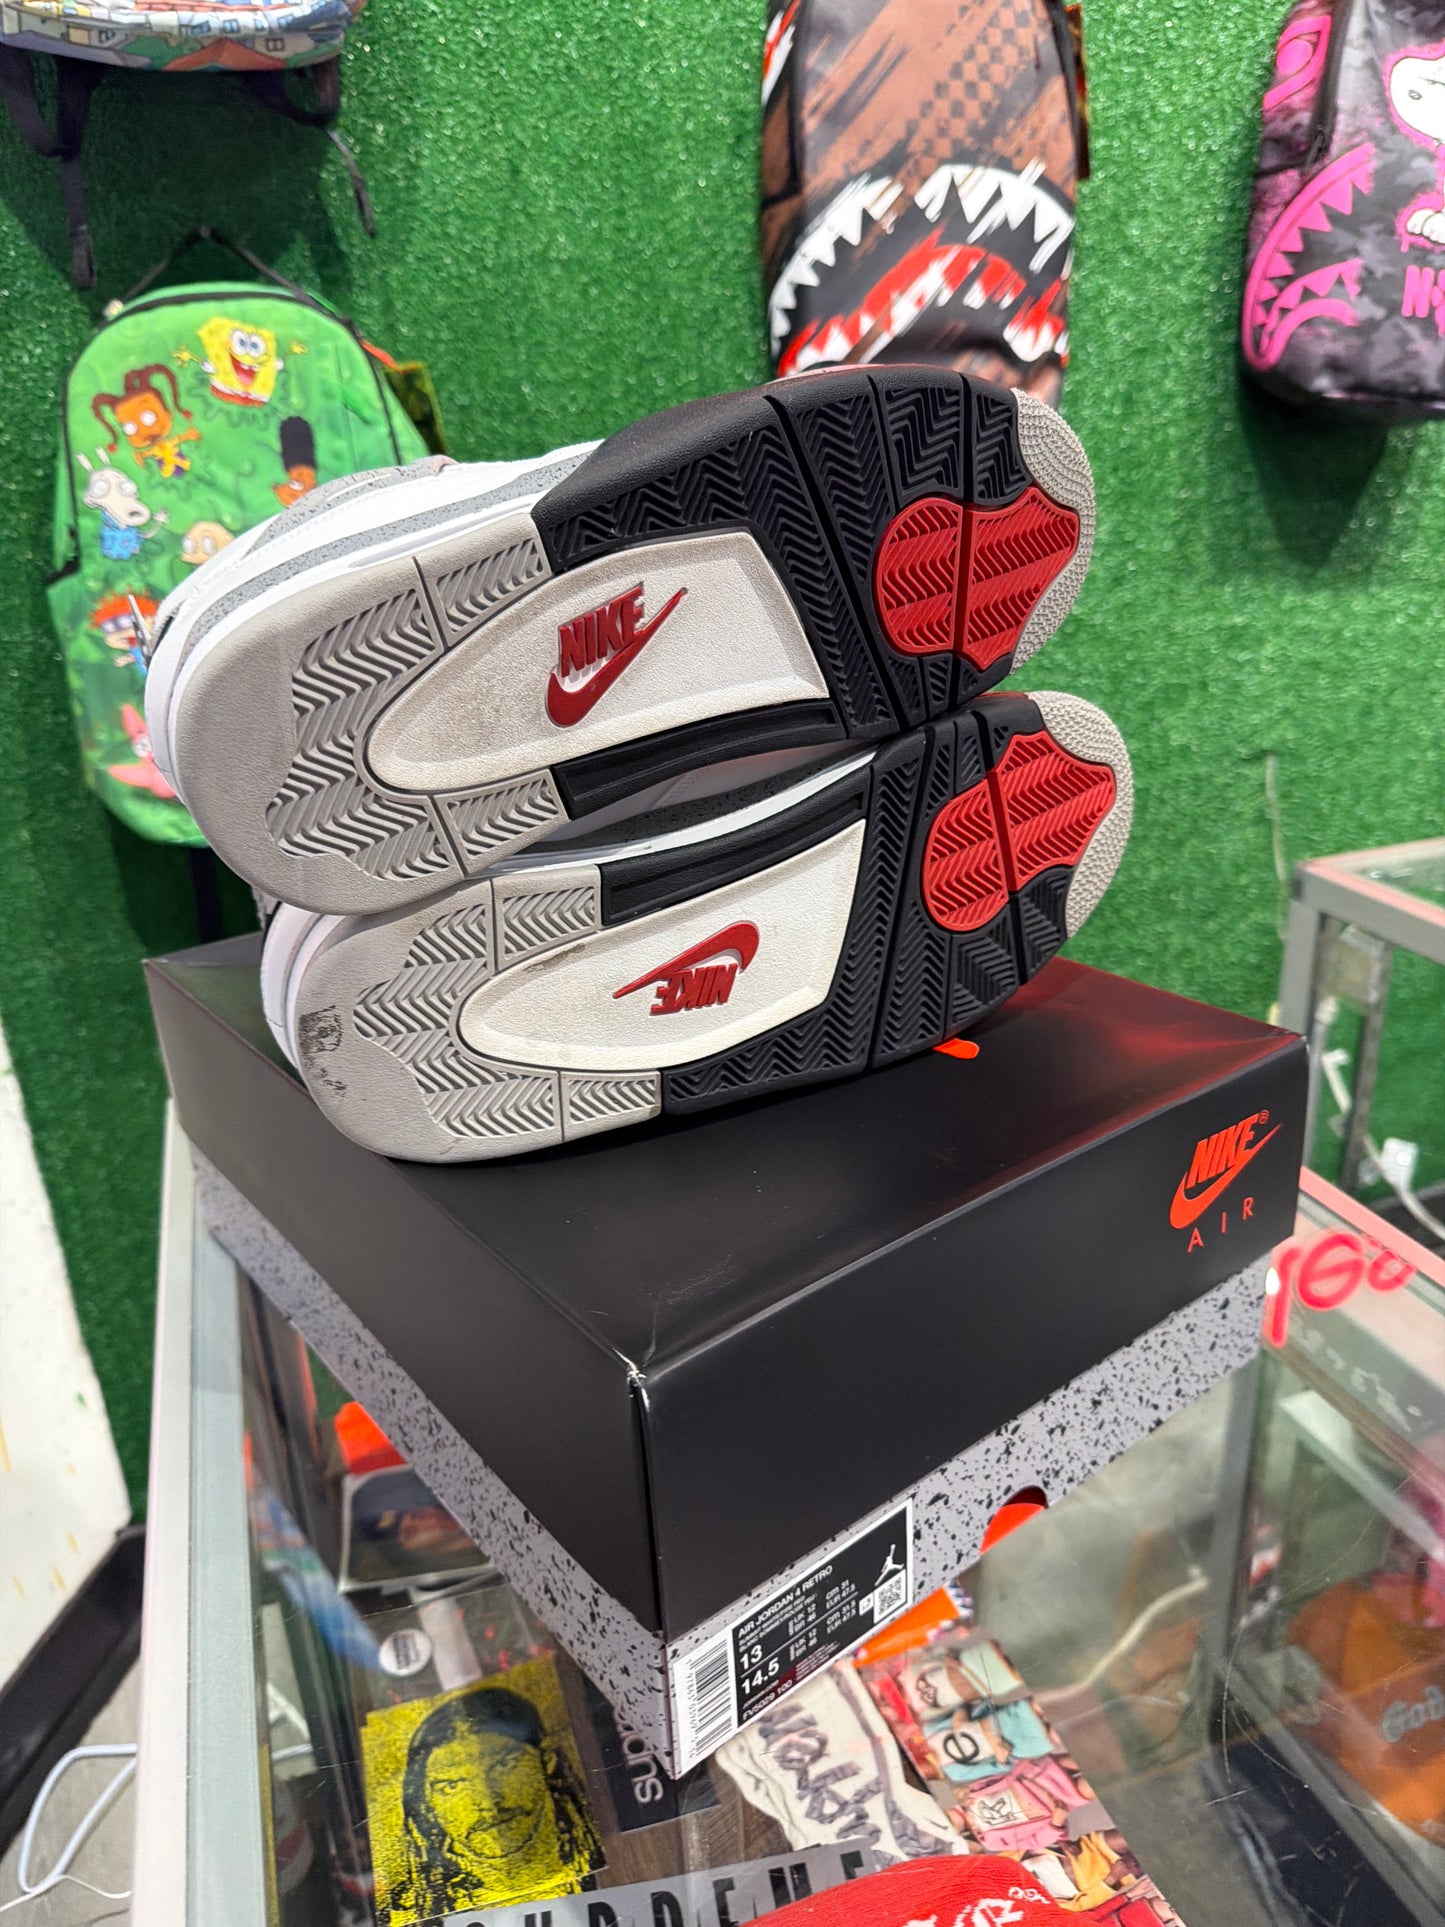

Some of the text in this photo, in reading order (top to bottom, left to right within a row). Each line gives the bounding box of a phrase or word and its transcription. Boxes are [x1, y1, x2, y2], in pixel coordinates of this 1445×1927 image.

[558, 582, 645, 677] NIKE
[649, 962, 738, 1017] NIKE
[1186, 1112, 1260, 1190] NIKE
[1187, 1196, 1255, 1254] AIR
[738, 1565, 833, 1638] AIR JORDAN 4 RETRO
[740, 1644, 763, 1670] 13
[741, 1657, 780, 1695] 14.5
